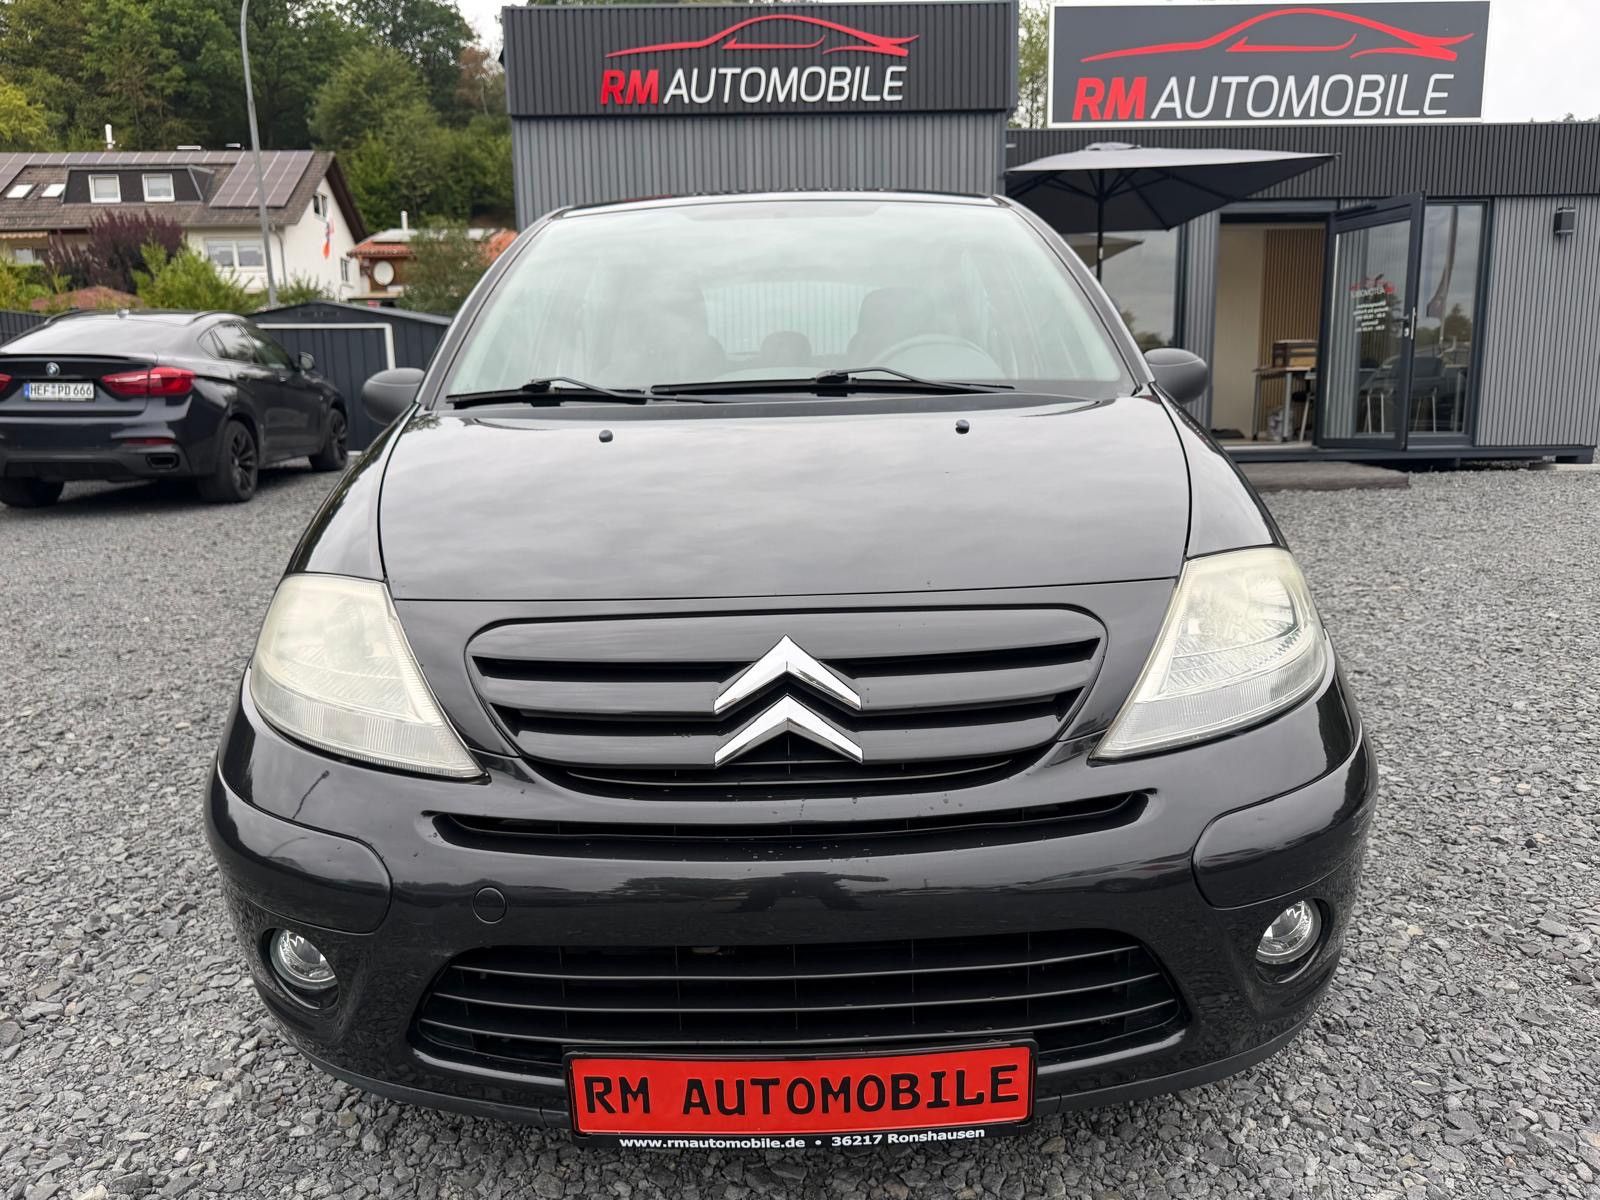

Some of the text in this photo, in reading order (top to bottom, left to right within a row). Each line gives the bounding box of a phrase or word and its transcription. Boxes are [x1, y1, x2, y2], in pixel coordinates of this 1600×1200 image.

[600, 65, 908, 105] RM AUTOMOBILE
[1071, 73, 1455, 121] RM AUTOMOBILE
[30, 384, 50, 396] HEF
[73, 384, 92, 396] 666
[583, 1064, 1019, 1116] RM AUTOMOBILE
[619, 1127, 985, 1149] www.rmautomobile.de 36217 Ronshausen
